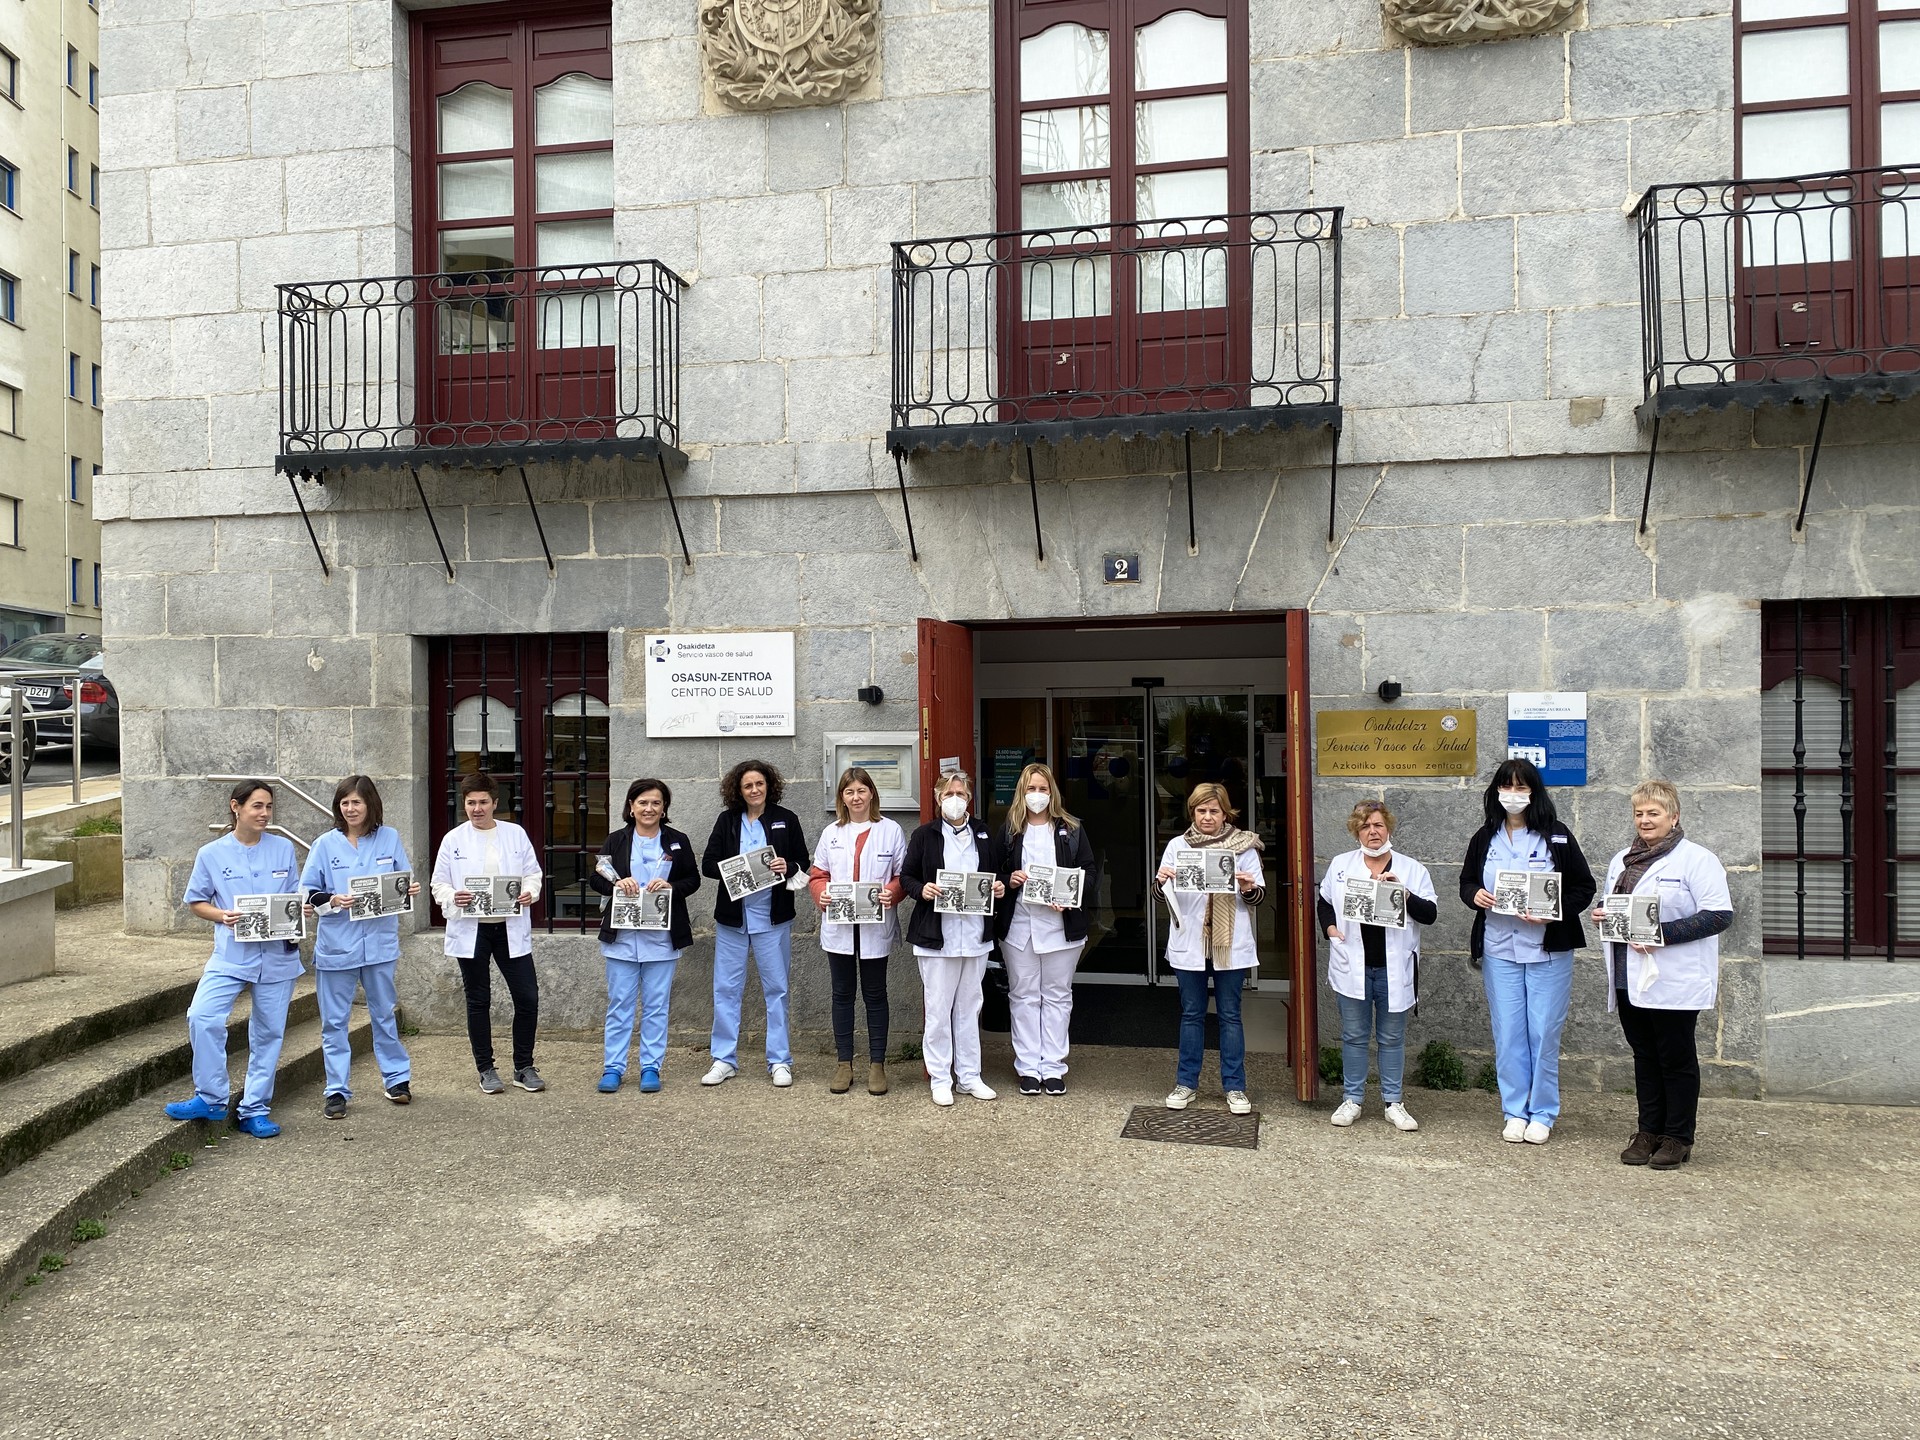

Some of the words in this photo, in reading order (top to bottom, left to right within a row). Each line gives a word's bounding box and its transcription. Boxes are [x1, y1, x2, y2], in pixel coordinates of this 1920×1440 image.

[1114, 559, 1128, 579] 2
[671, 671, 773, 683] OSASUN-ZENTROA
[671, 687, 717, 698] CENTRO
[719, 687, 735, 697] DE
[737, 686, 774, 697] SALUD
[1364, 716, 1428, 732] Osakidetza
[1323, 737, 1370, 752] Servicio
[1373, 737, 1407, 752] Vasco
[1412, 738, 1426, 752] de
[1433, 736, 1471, 752] Salud
[1332, 761, 1376, 770] Azkoitiko
[1384, 762, 1417, 770] osasun
[1425, 761, 1463, 770] zentroa
